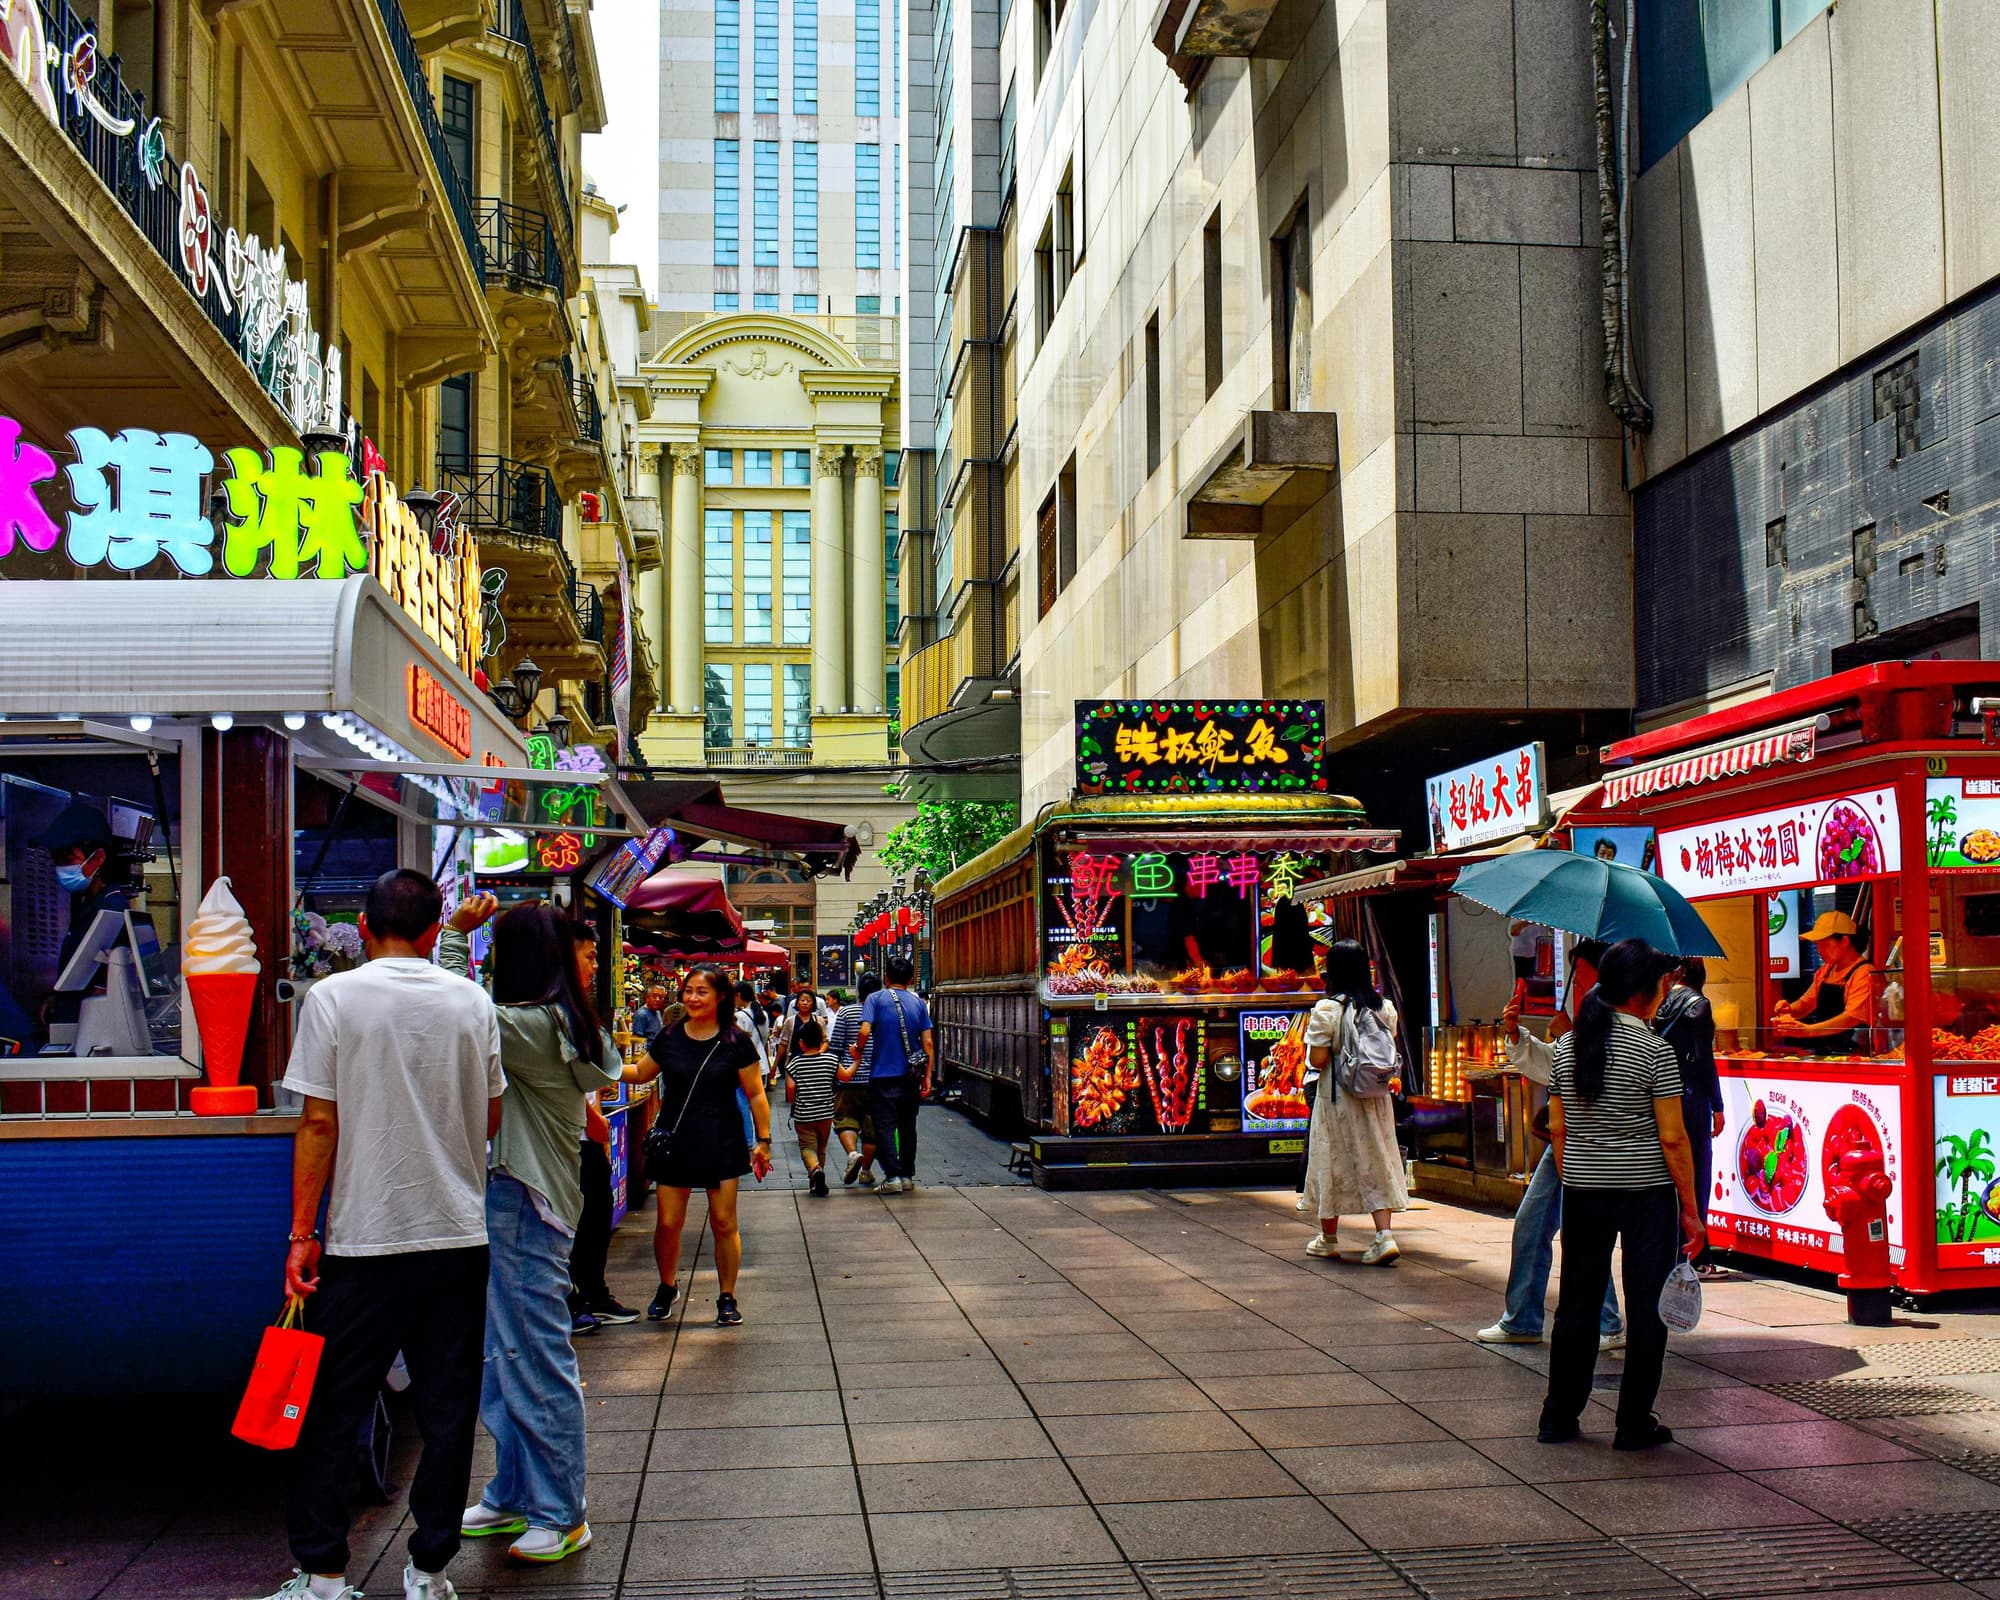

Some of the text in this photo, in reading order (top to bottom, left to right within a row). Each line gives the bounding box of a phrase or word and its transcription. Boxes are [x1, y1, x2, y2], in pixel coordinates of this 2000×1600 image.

[1928, 759, 1944, 771] 01
[1448, 750, 1532, 831] 超级大串
[1695, 819, 1799, 879] 杨梅冰汤圆
[1071, 851, 1303, 900] 鱿鱼串串香
[1244, 1016, 1289, 1031] 串串香
[1735, 1218, 1771, 1239] 吃了还想吃
[1776, 1227, 1824, 1249] 好味源于用心
